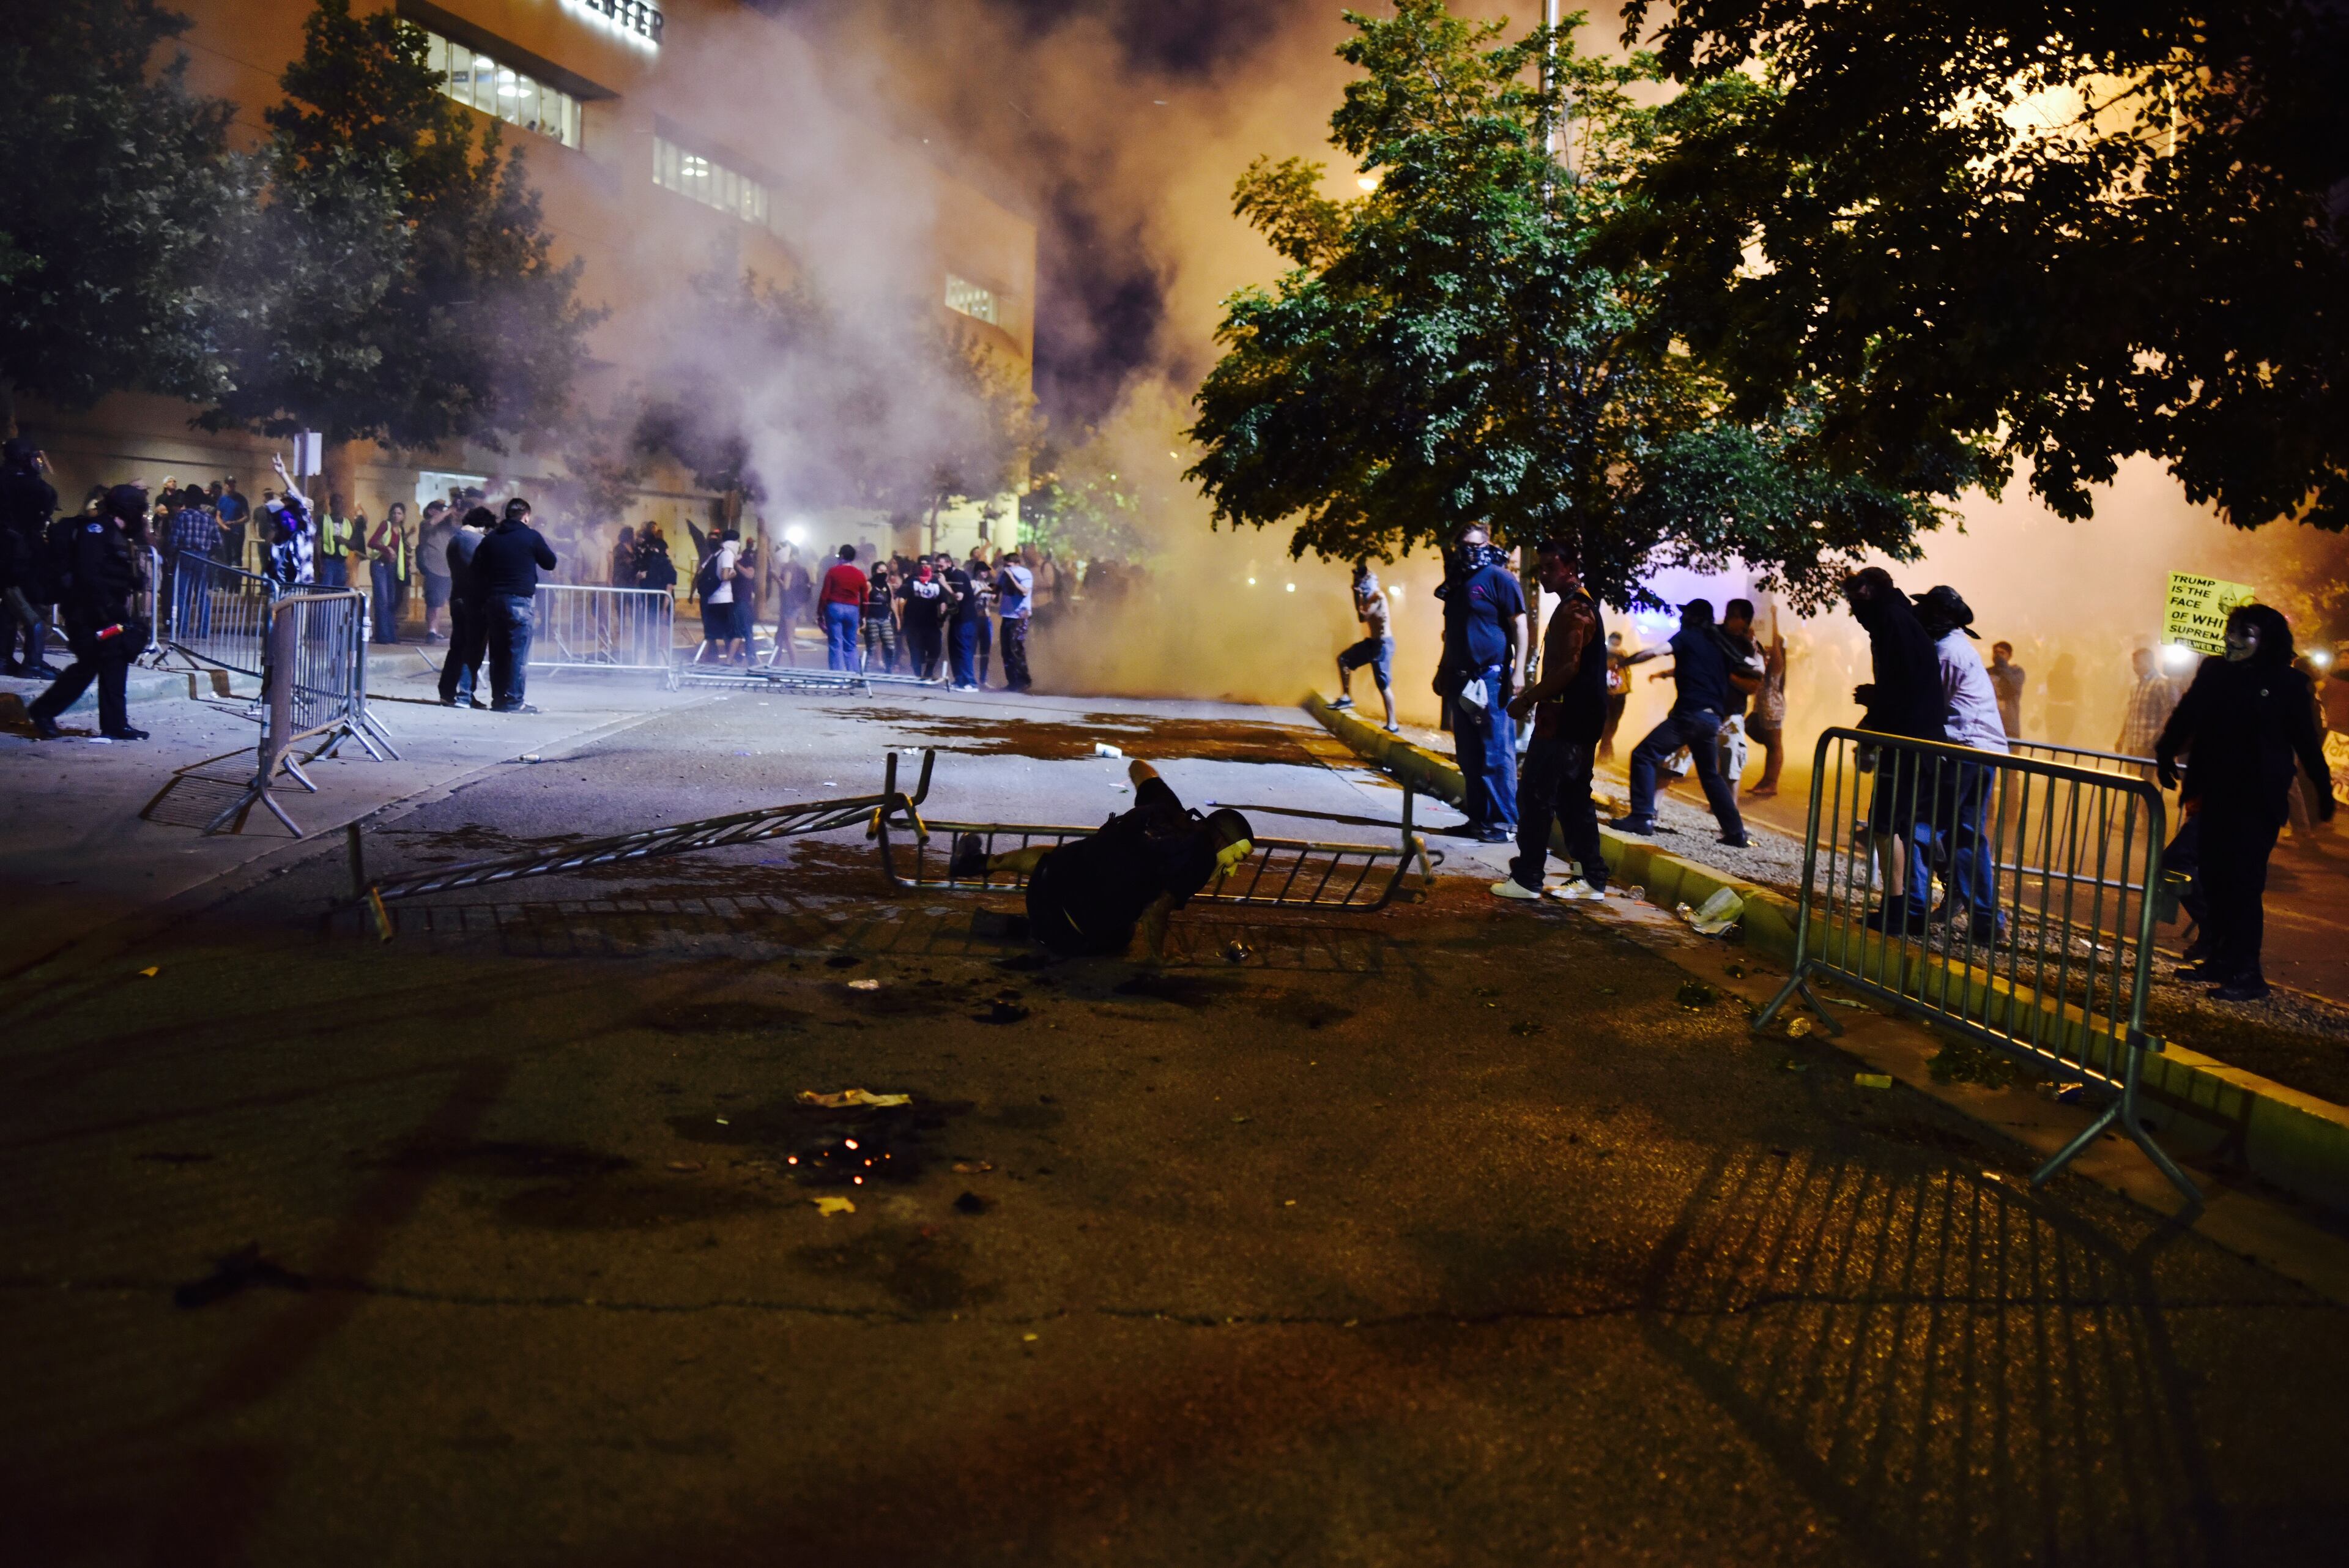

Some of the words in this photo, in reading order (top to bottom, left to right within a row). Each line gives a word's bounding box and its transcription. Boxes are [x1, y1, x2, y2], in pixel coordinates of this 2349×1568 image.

[573, 0, 664, 46] NTER
[2173, 575, 2216, 587] TRUMP
[2188, 587, 2212, 598] THE
[2170, 597, 2202, 609] FACE
[2172, 611, 2189, 620] OF
